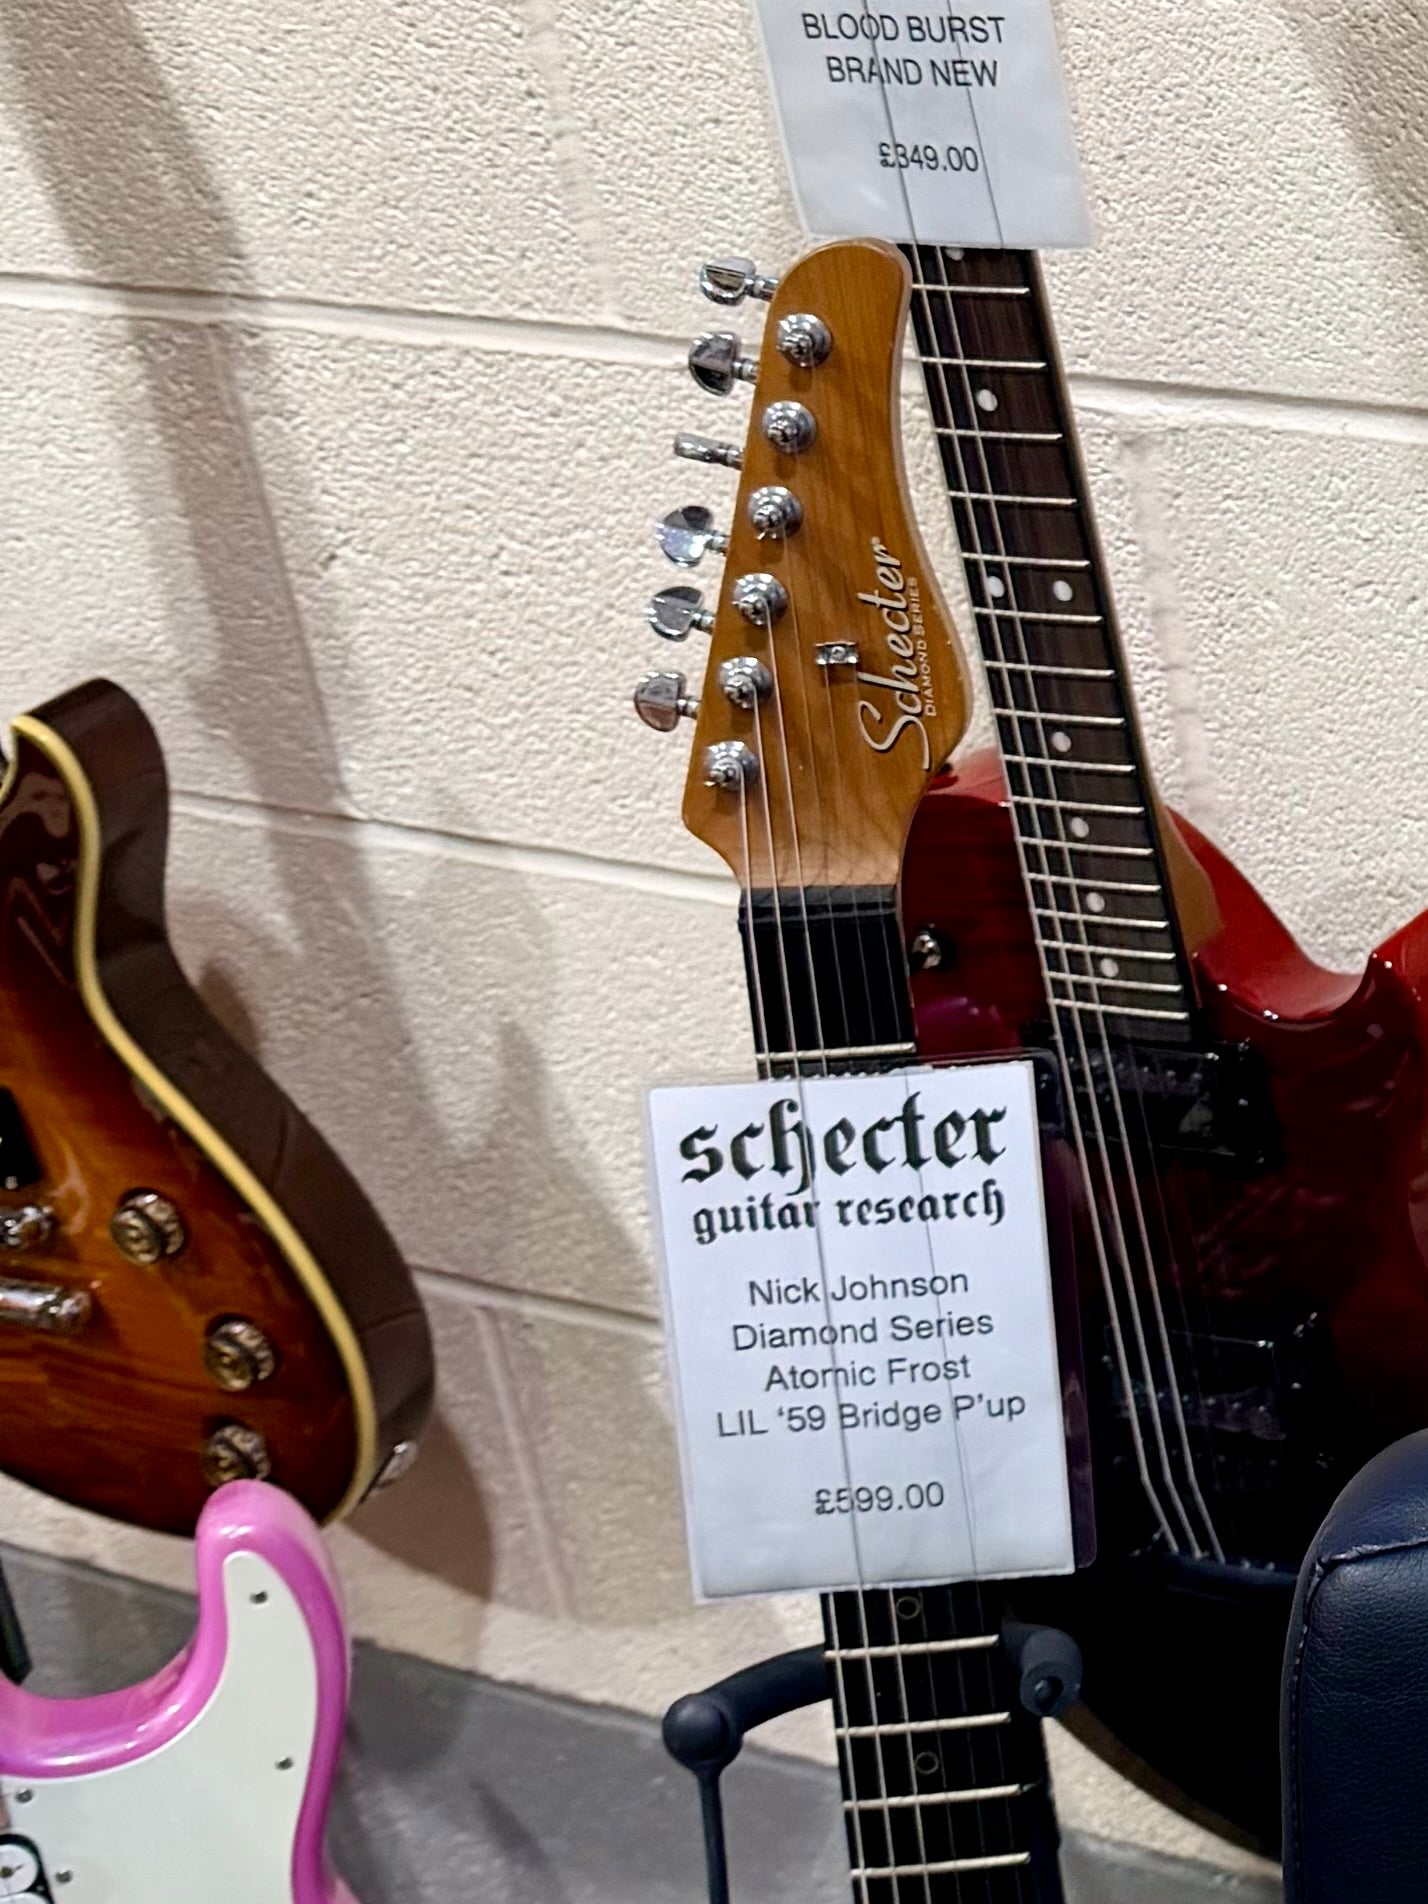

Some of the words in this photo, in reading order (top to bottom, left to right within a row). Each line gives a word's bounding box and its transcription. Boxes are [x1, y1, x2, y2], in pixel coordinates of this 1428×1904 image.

[802, 13, 898, 42] BLOOD
[908, 16, 1005, 43] BURST
[827, 57, 922, 86] BRAND
[931, 59, 998, 87] NEW
[907, 576, 925, 637] SERIES
[857, 542, 930, 769] Schecter
[915, 639, 937, 717] DIAMOND
[679, 1091, 1009, 1196] schecter
[693, 1191, 821, 1245] guitar
[836, 1179, 1007, 1226] research
[749, 1277, 820, 1307] Nick
[831, 1270, 970, 1302] Johnson
[732, 1319, 878, 1353] Diamond
[890, 1311, 995, 1340] Series
[765, 1361, 877, 1392] Atomic
[888, 1355, 972, 1387] Frost
[716, 1409, 769, 1439] LIL
[839, 1397, 943, 1431] Bridge
[815, 1481, 945, 1516] £599.00
